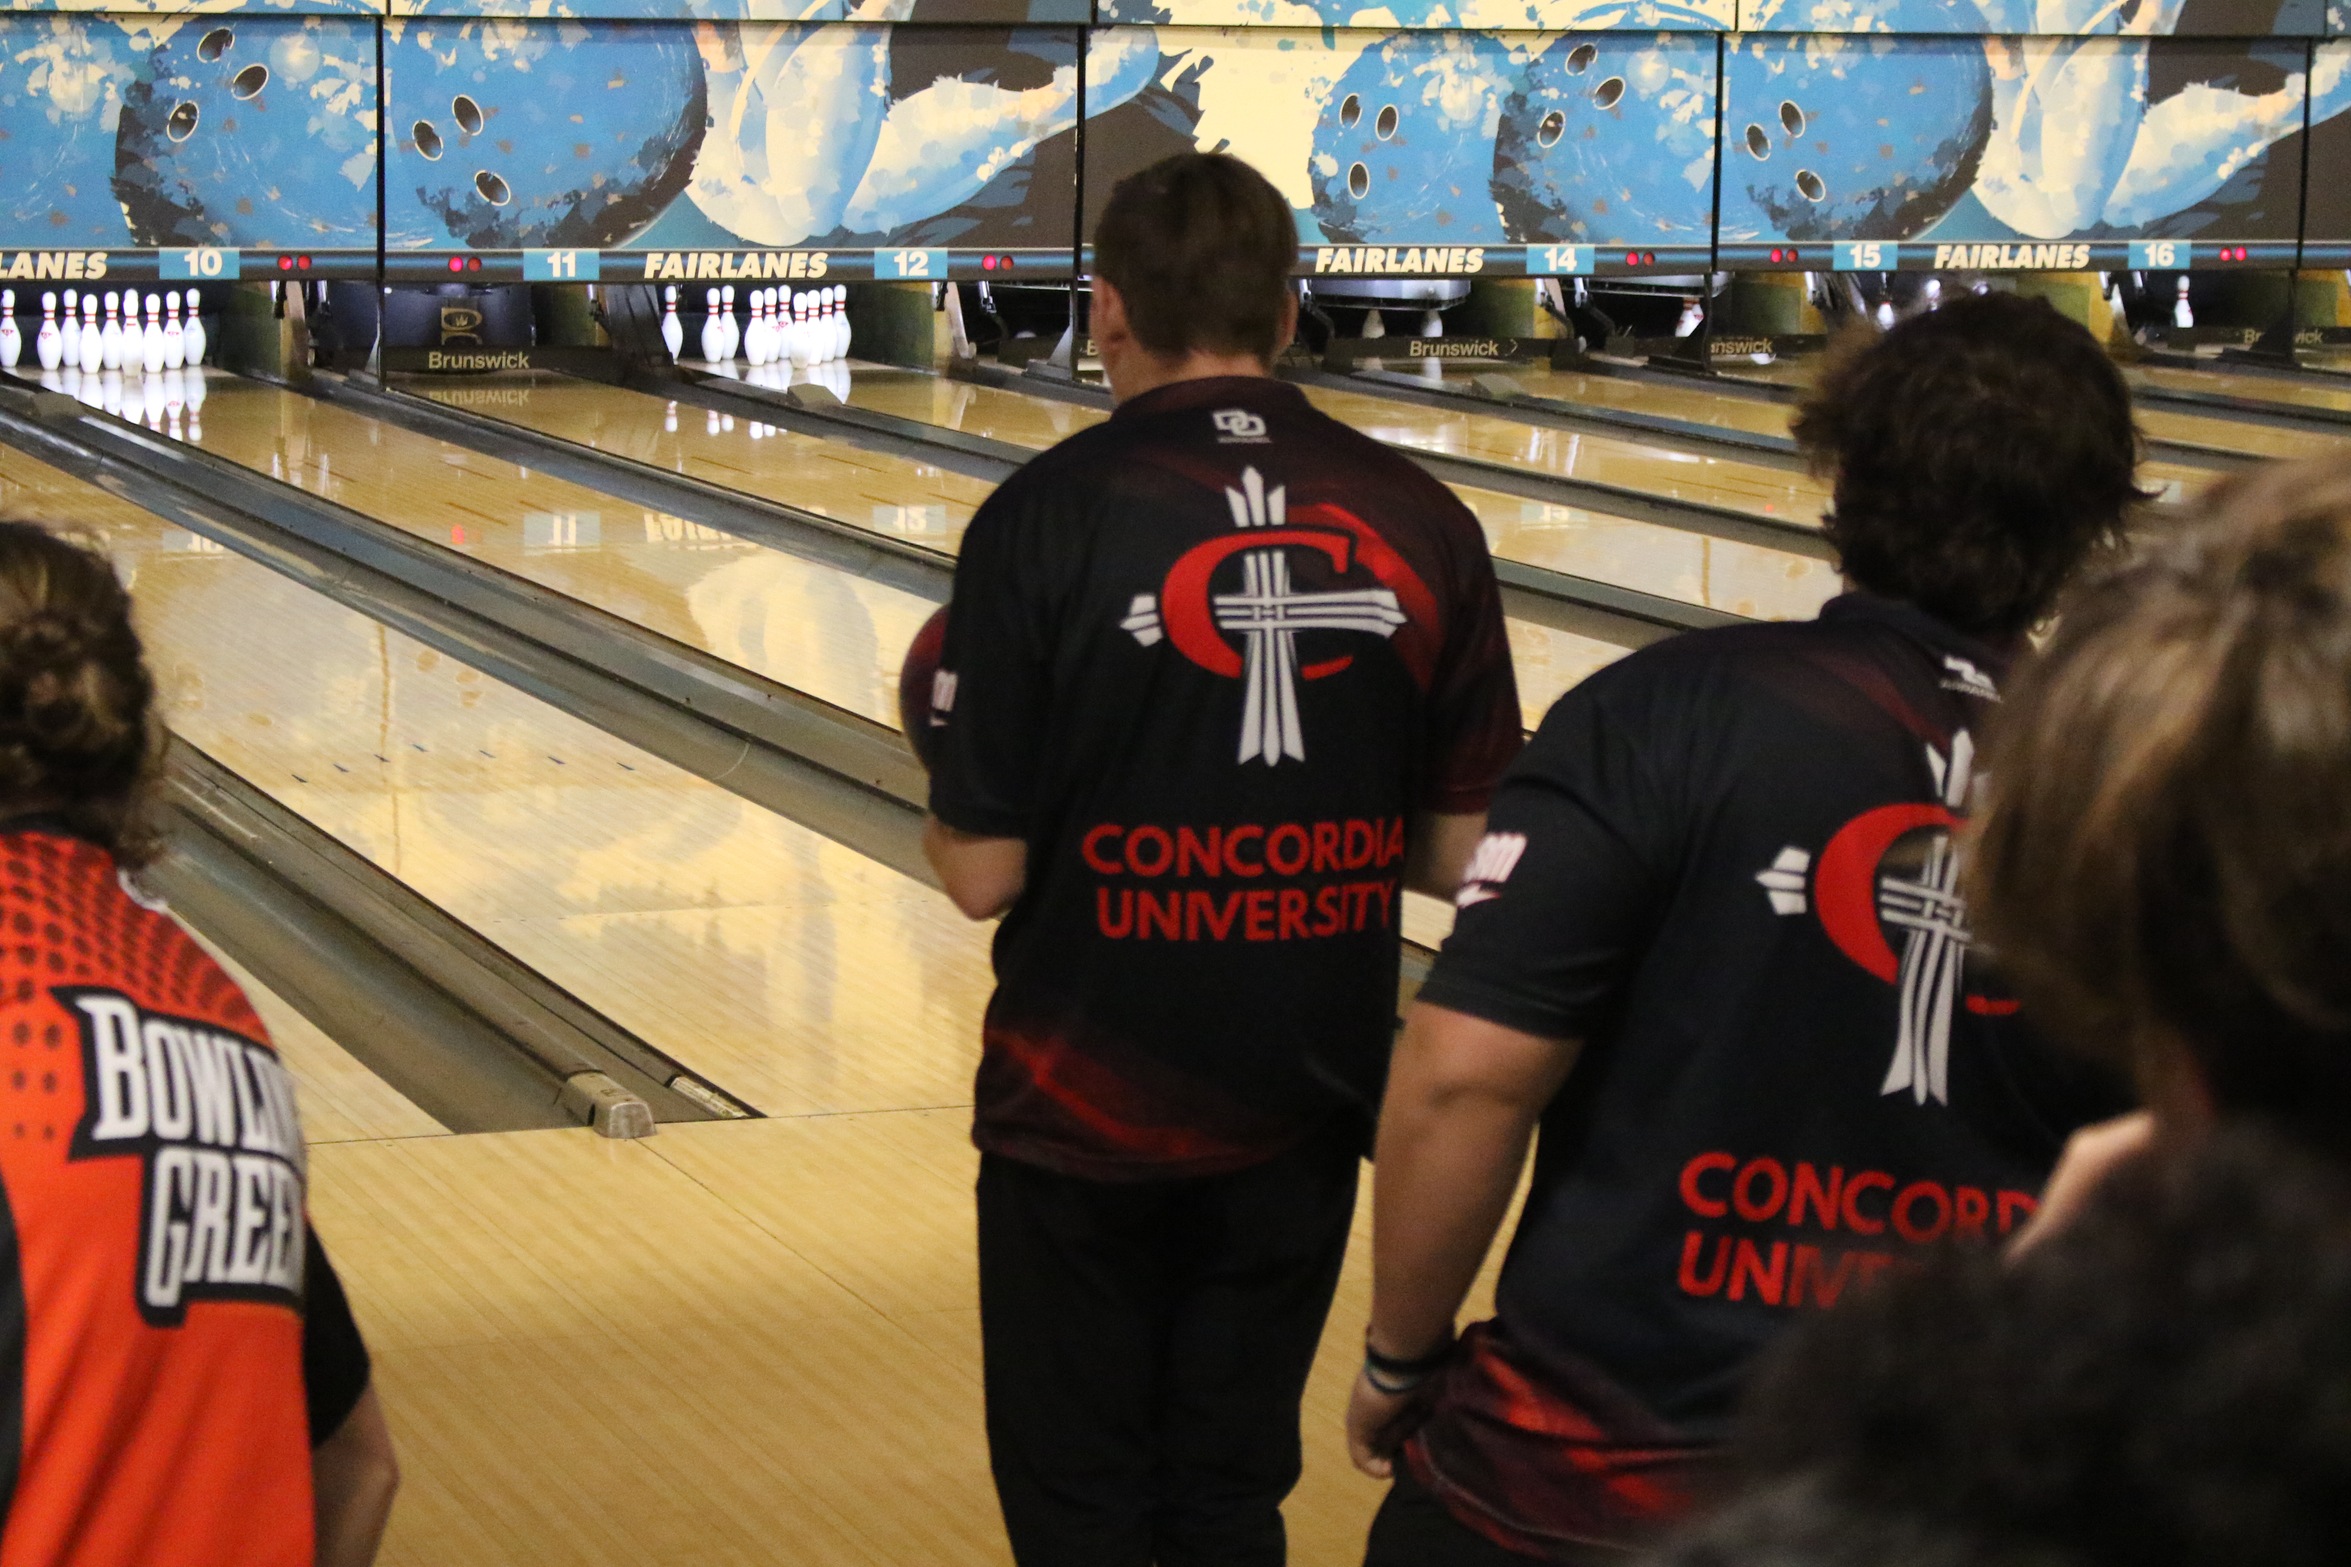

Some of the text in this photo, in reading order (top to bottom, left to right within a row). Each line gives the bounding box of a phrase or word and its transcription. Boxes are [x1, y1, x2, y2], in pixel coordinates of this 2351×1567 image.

[184, 252, 223, 277] 10
[547, 252, 576, 277] 11
[644, 253, 828, 279] FAIRLANES
[893, 251, 928, 276] 12
[1315, 248, 1484, 273] FAIRLANES
[1544, 247, 1578, 272] 14
[1851, 244, 1882, 269] 15
[1934, 244, 2091, 269] FAIRLANES
[2144, 243, 2175, 267] 16
[428, 351, 530, 369] Brunswick
[1410, 340, 1499, 357] Brunswick
[1098, 879, 1396, 941] UNIVERSITY
